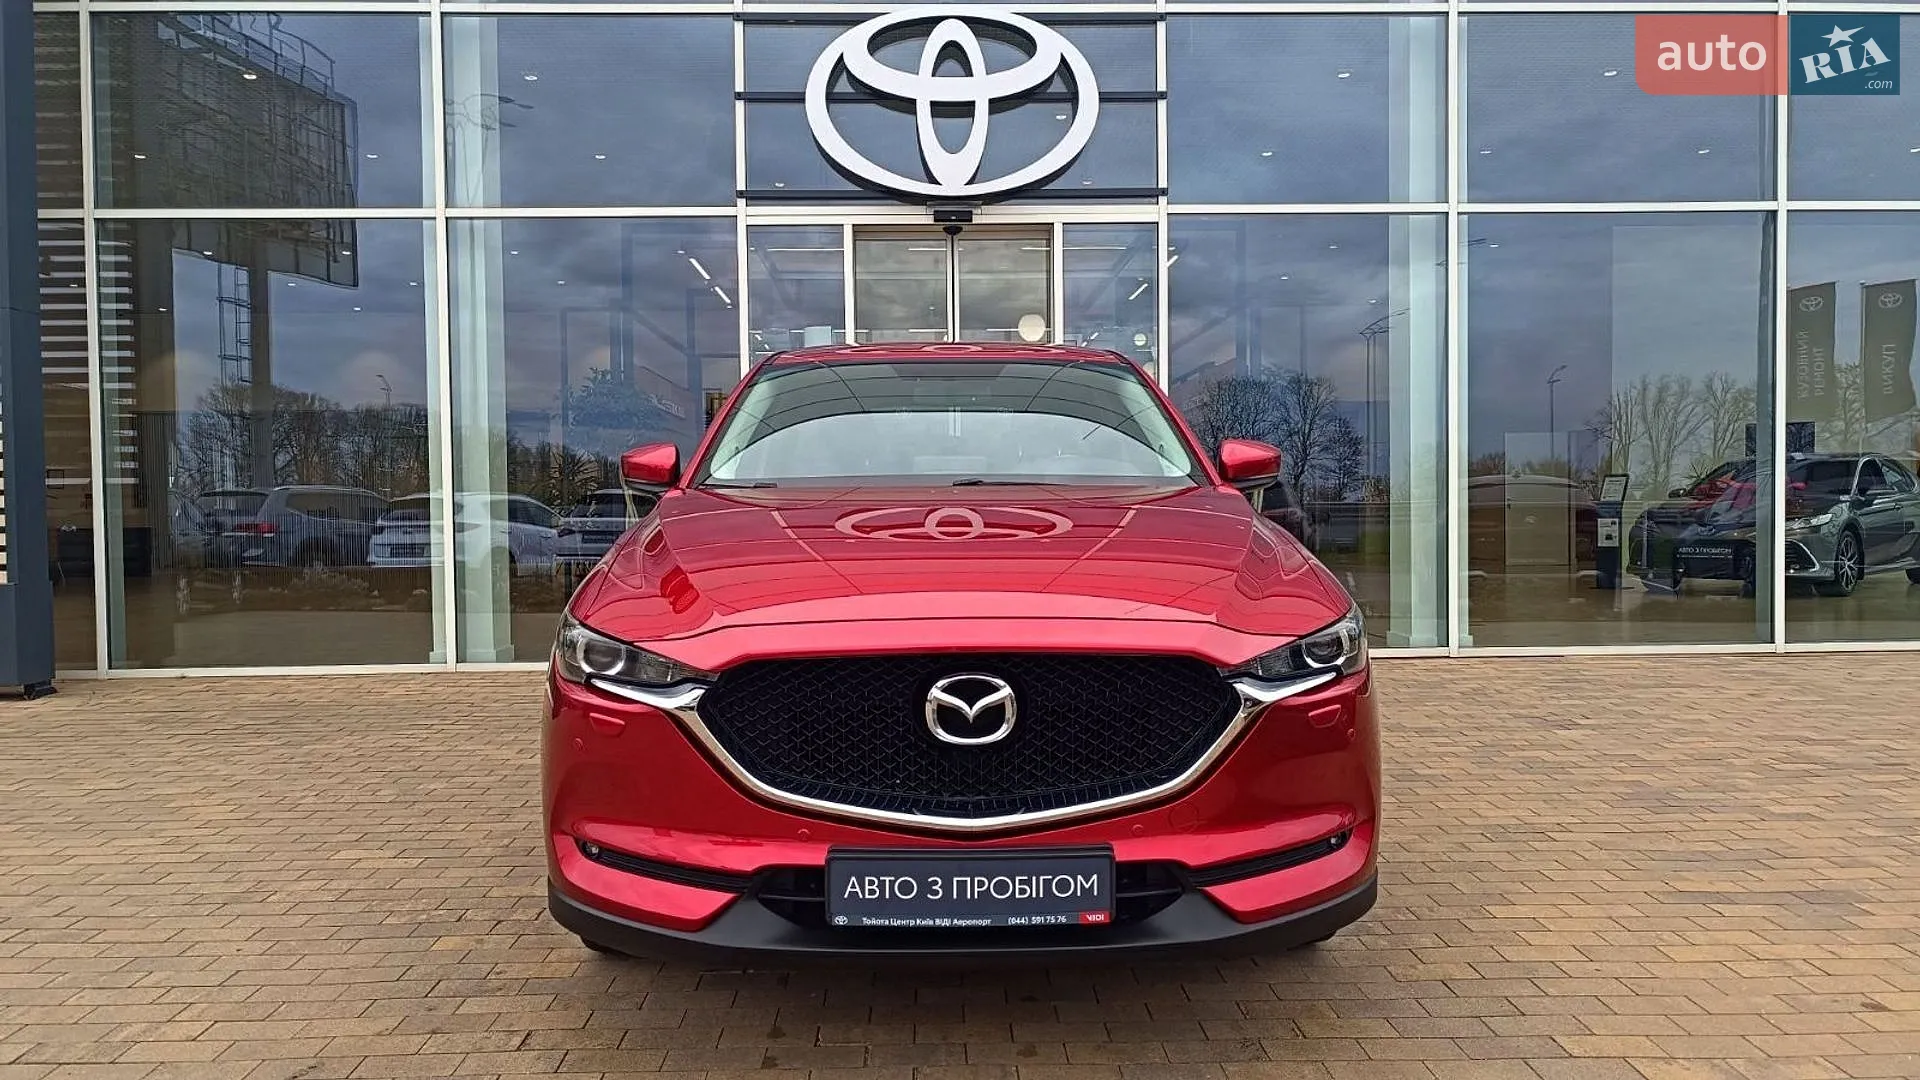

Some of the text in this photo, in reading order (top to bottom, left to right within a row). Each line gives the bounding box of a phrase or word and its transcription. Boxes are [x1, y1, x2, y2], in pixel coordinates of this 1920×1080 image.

[844, 873, 1098, 899] АВТО З ПРОБІГОМ
[862, 917, 889, 926] Тойота
[890, 917, 915, 927] Центр
[952, 917, 992, 927] Аеропорт
[1007, 916, 1029, 925] (044)
